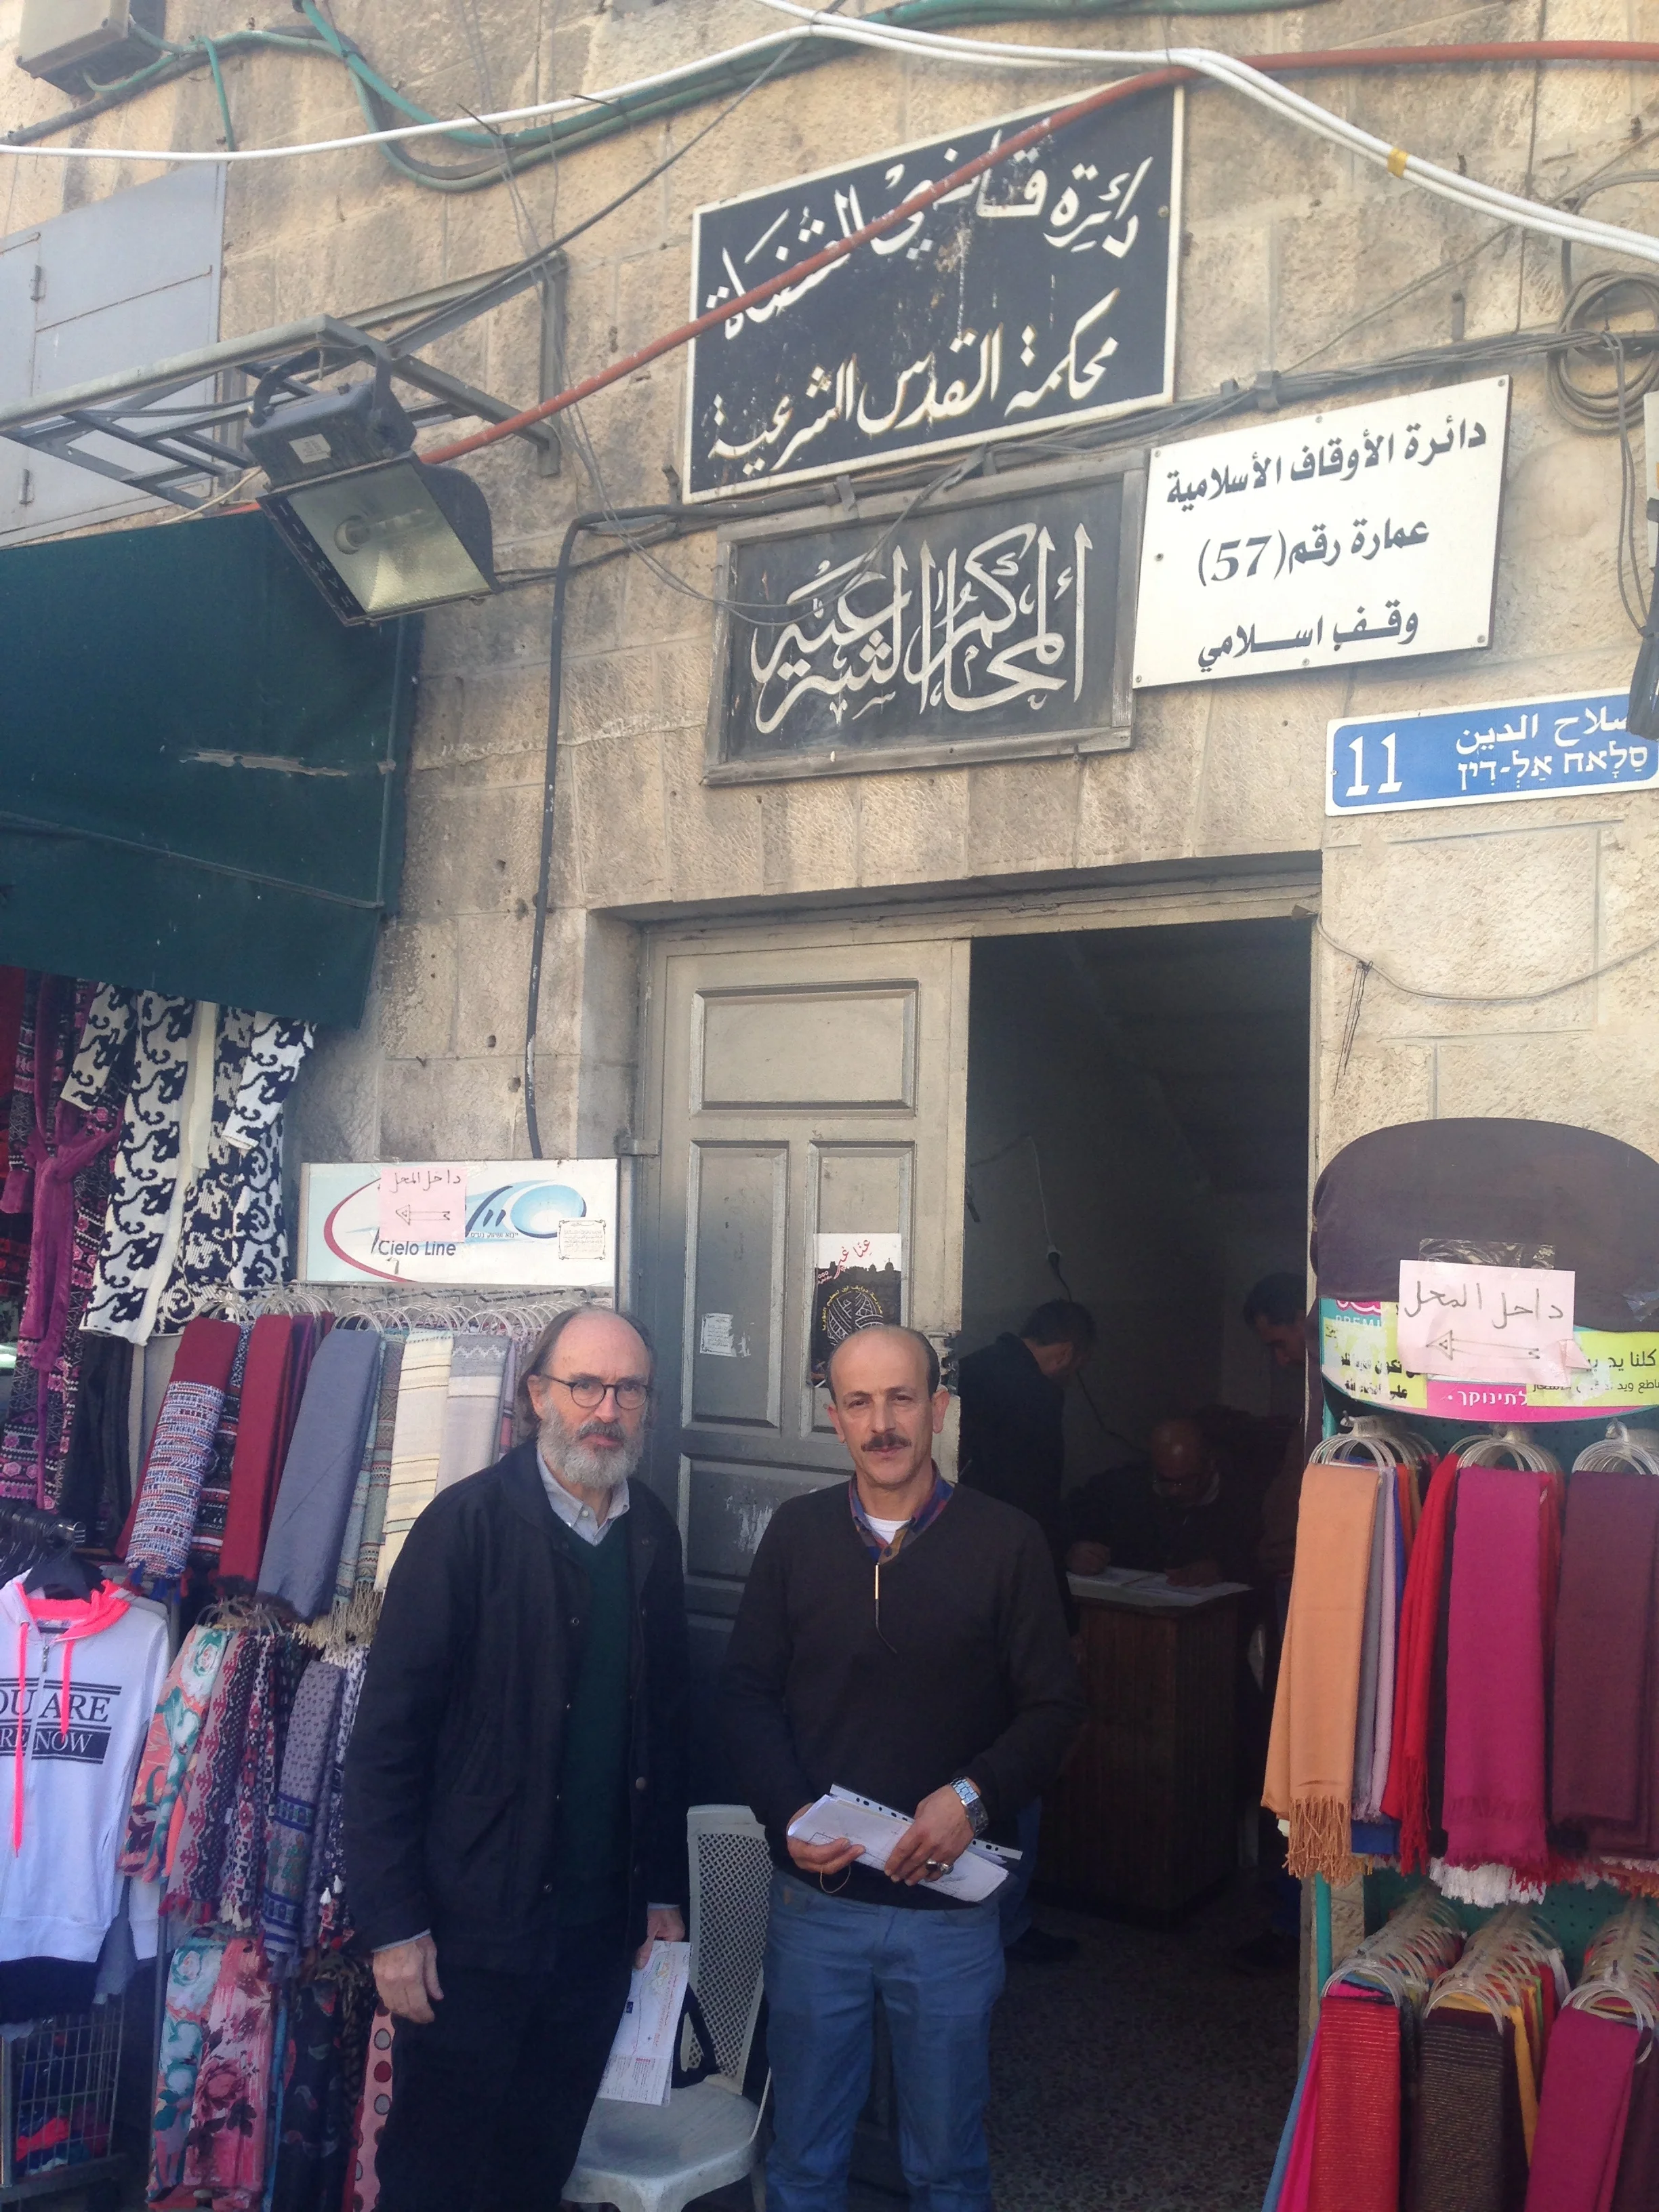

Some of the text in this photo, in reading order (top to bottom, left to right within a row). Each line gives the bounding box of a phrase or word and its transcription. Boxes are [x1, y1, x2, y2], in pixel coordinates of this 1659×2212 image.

[708, 287, 1120, 476] محكمة القدس الشرعية
[1166, 415, 1487, 512] دائرة الأوقاف الأسلامية
[1351, 517, 1430, 560] عمارة
[1197, 599, 1419, 673] وقف اسلامي
[1455, 705, 1627, 755] لاح الدين
[1345, 732, 1404, 797] 11
[377, 1240, 457, 1256] Cielo Line
[1404, 1280, 1482, 1318] المحل
[1630, 1347, 1658, 1368] كلنا
[38, 1692, 110, 1723] ARE
[34, 1730, 94, 1753] NOW
